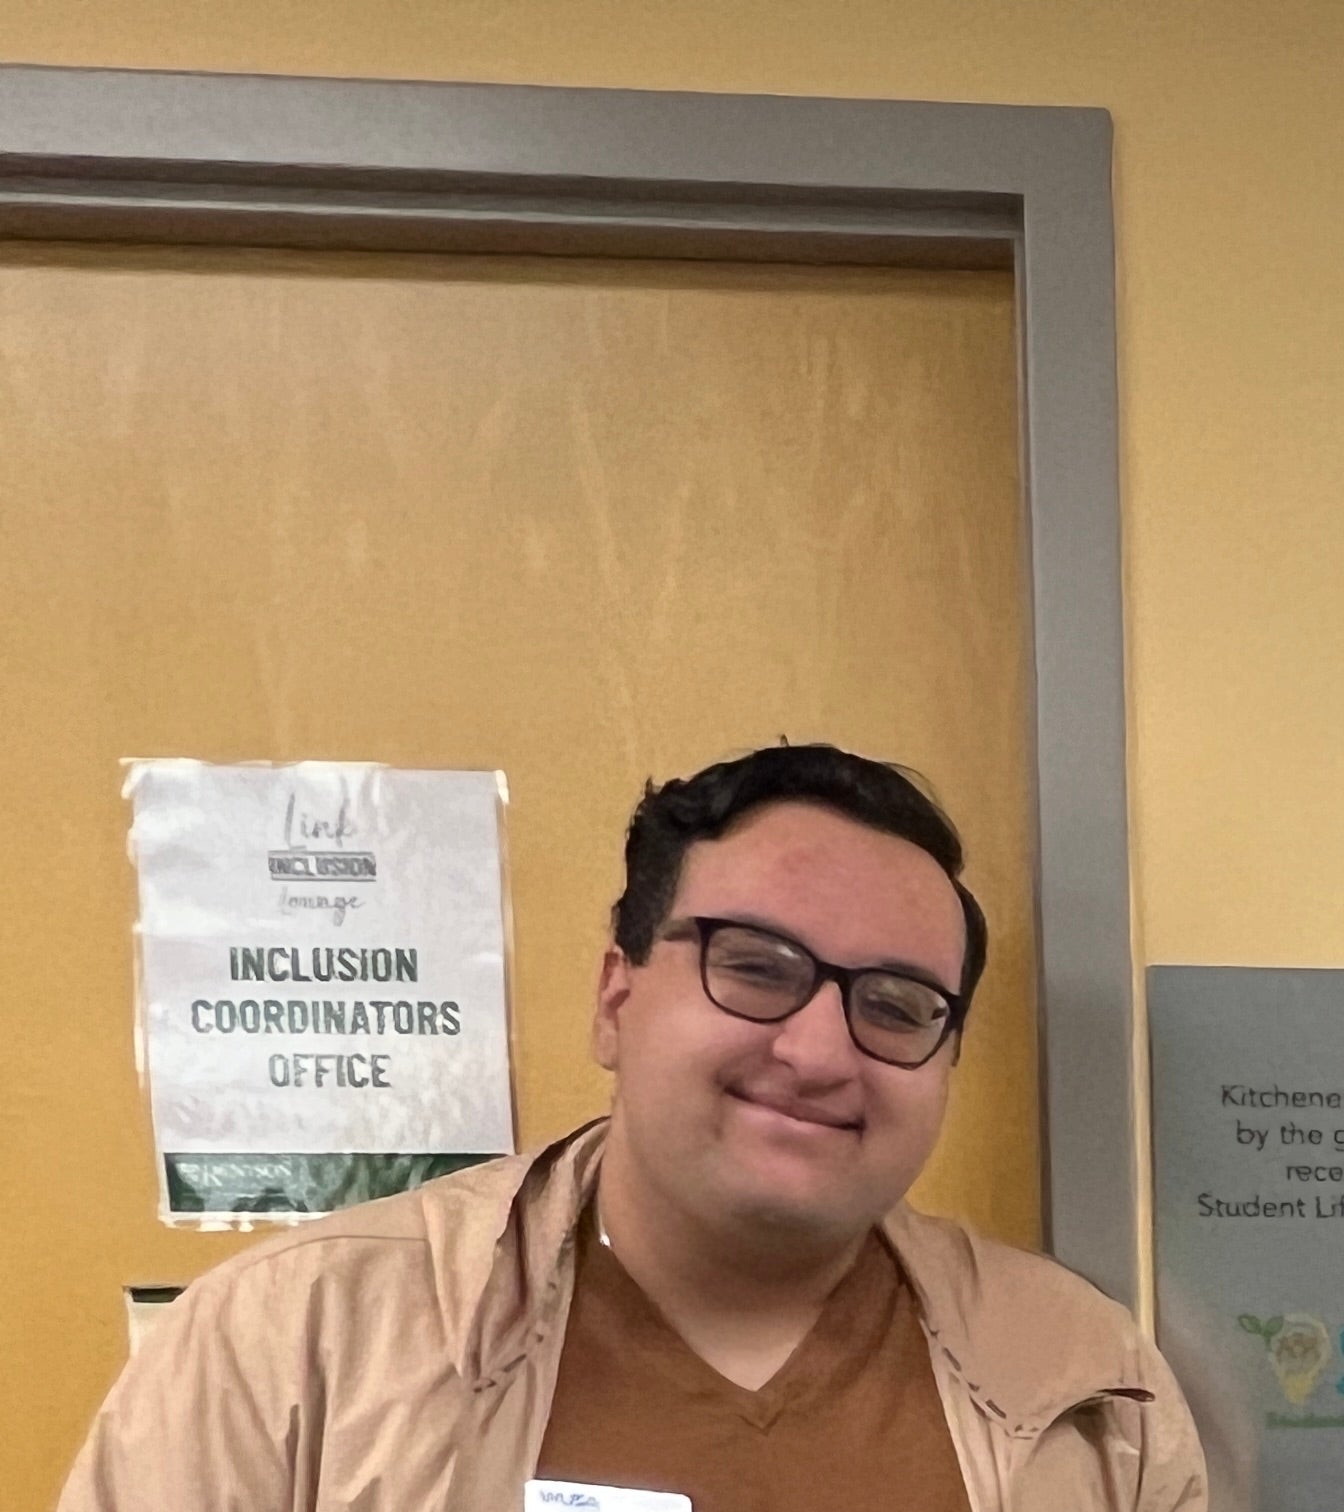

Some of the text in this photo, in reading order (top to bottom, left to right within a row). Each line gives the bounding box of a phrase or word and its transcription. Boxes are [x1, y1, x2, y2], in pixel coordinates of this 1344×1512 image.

[268, 856, 377, 877] INCLUSION
[229, 946, 420, 984] INCLUSION
[190, 999, 463, 1038] COORDINATORS
[268, 1053, 394, 1091] OFFICE
[1236, 1119, 1270, 1153] by
[1280, 1122, 1325, 1147] the
[1197, 1193, 1307, 1220] Student
